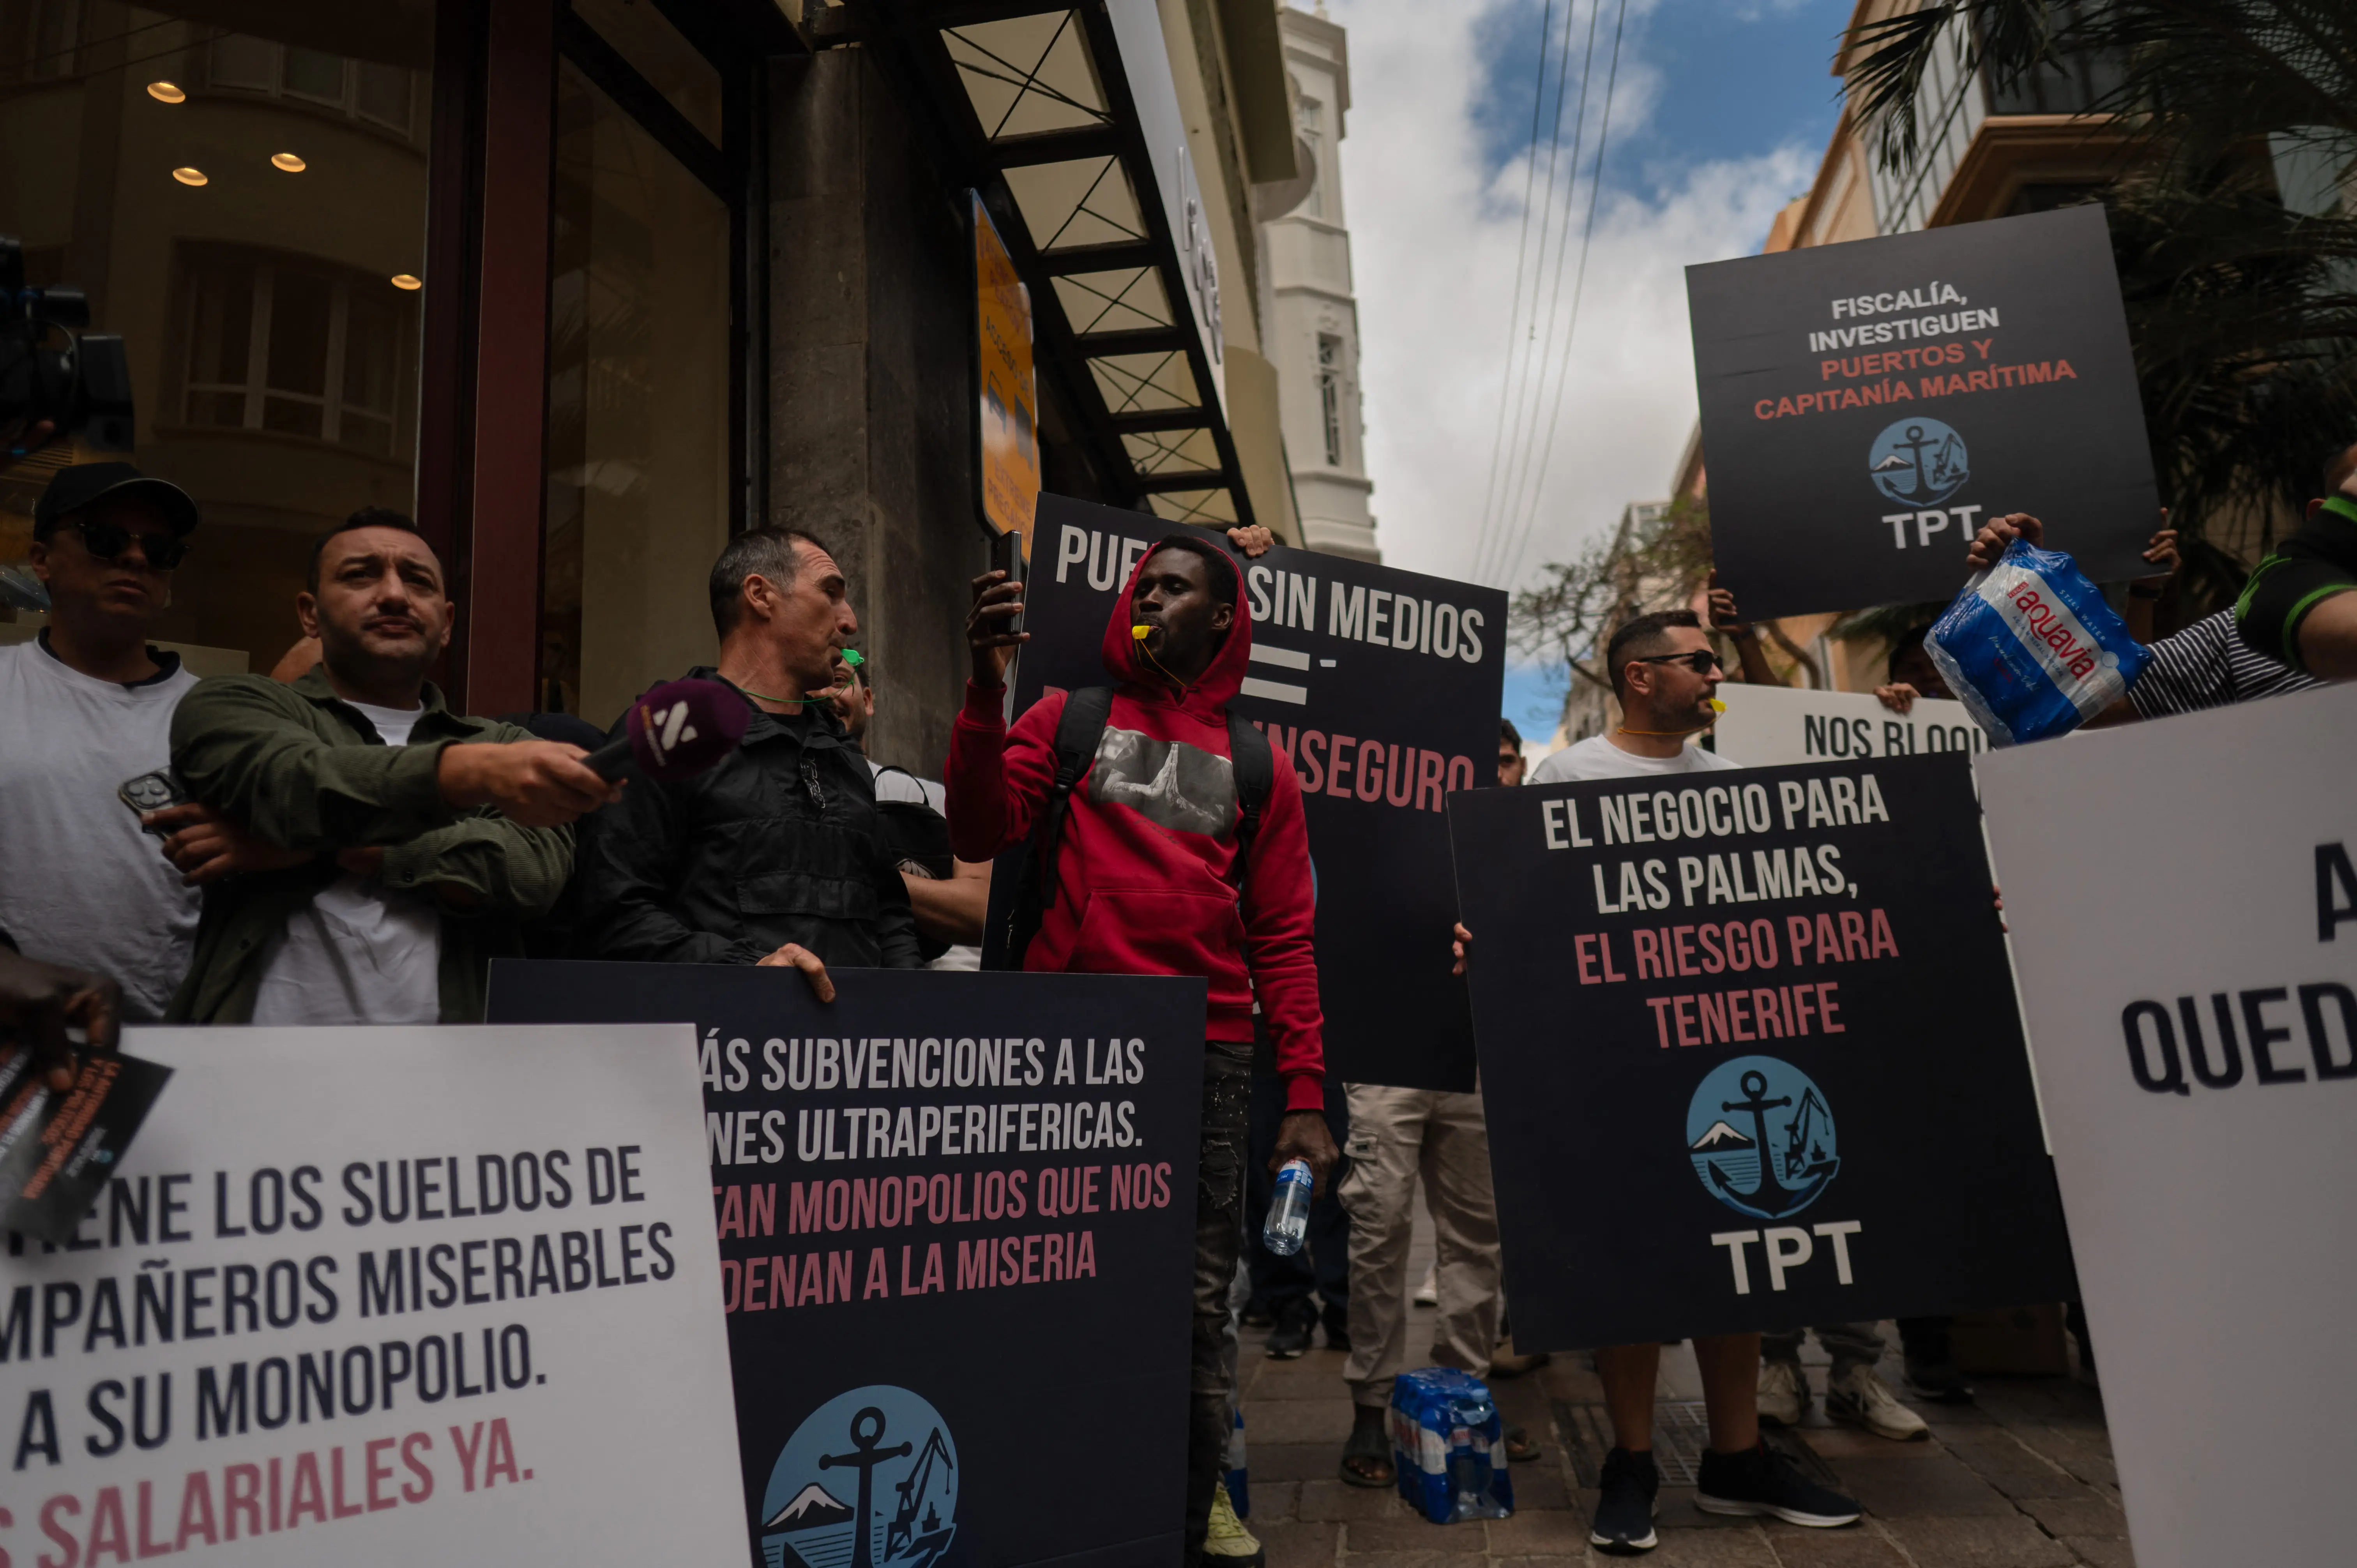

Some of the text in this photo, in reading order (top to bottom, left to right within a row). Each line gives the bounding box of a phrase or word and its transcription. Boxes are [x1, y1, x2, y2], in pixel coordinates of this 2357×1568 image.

[1809, 307, 1999, 352] INVESTIGUEN
[1832, 281, 1967, 319] FISCALÍA,
[1755, 360, 2076, 420] CAPITANÍA MARÍTIMA
[1822, 339, 1992, 380] PUERTOS Y
[1882, 505, 1983, 549] TPT
[1248, 565, 1316, 631] SIN
[1329, 581, 1484, 663] MEDIOS
[2026, 630, 2045, 654] MINERAL
[2059, 589, 2106, 641] STILL WATER
[1805, 714, 1872, 759] NOS
[1542, 774, 1889, 849] EL NEGOCIO PARA
[1593, 844, 1857, 913] LAS PALMAS,
[1574, 909, 1899, 984] EL RIESGO PARA
[1647, 982, 1845, 1048] TENERIFE
[762, 1038, 1044, 1090] SUBVENCIONES
[1053, 1039, 1075, 1085] A
[1086, 1038, 1144, 1084] LAS
[798, 1101, 1142, 1161] ULTRAPERIFERICAS.
[216, 1165, 322, 1238] LOS
[342, 1150, 572, 1226] SUELDOS
[586, 1145, 644, 1205] DE
[712, 1162, 1171, 1239] AN MONOPOLIOS QUE NOS
[359, 1222, 675, 1317] MISERABLES
[864, 1248, 888, 1299] A
[901, 1243, 944, 1296] LA
[957, 1231, 1096, 1290] MISERIA
[1711, 1220, 1861, 1294] TPT
[14, 1324, 545, 1470] A SU MONOPOLIO.
[39, 1432, 433, 1568] SALARIALES
[449, 1418, 532, 1492] YA.
